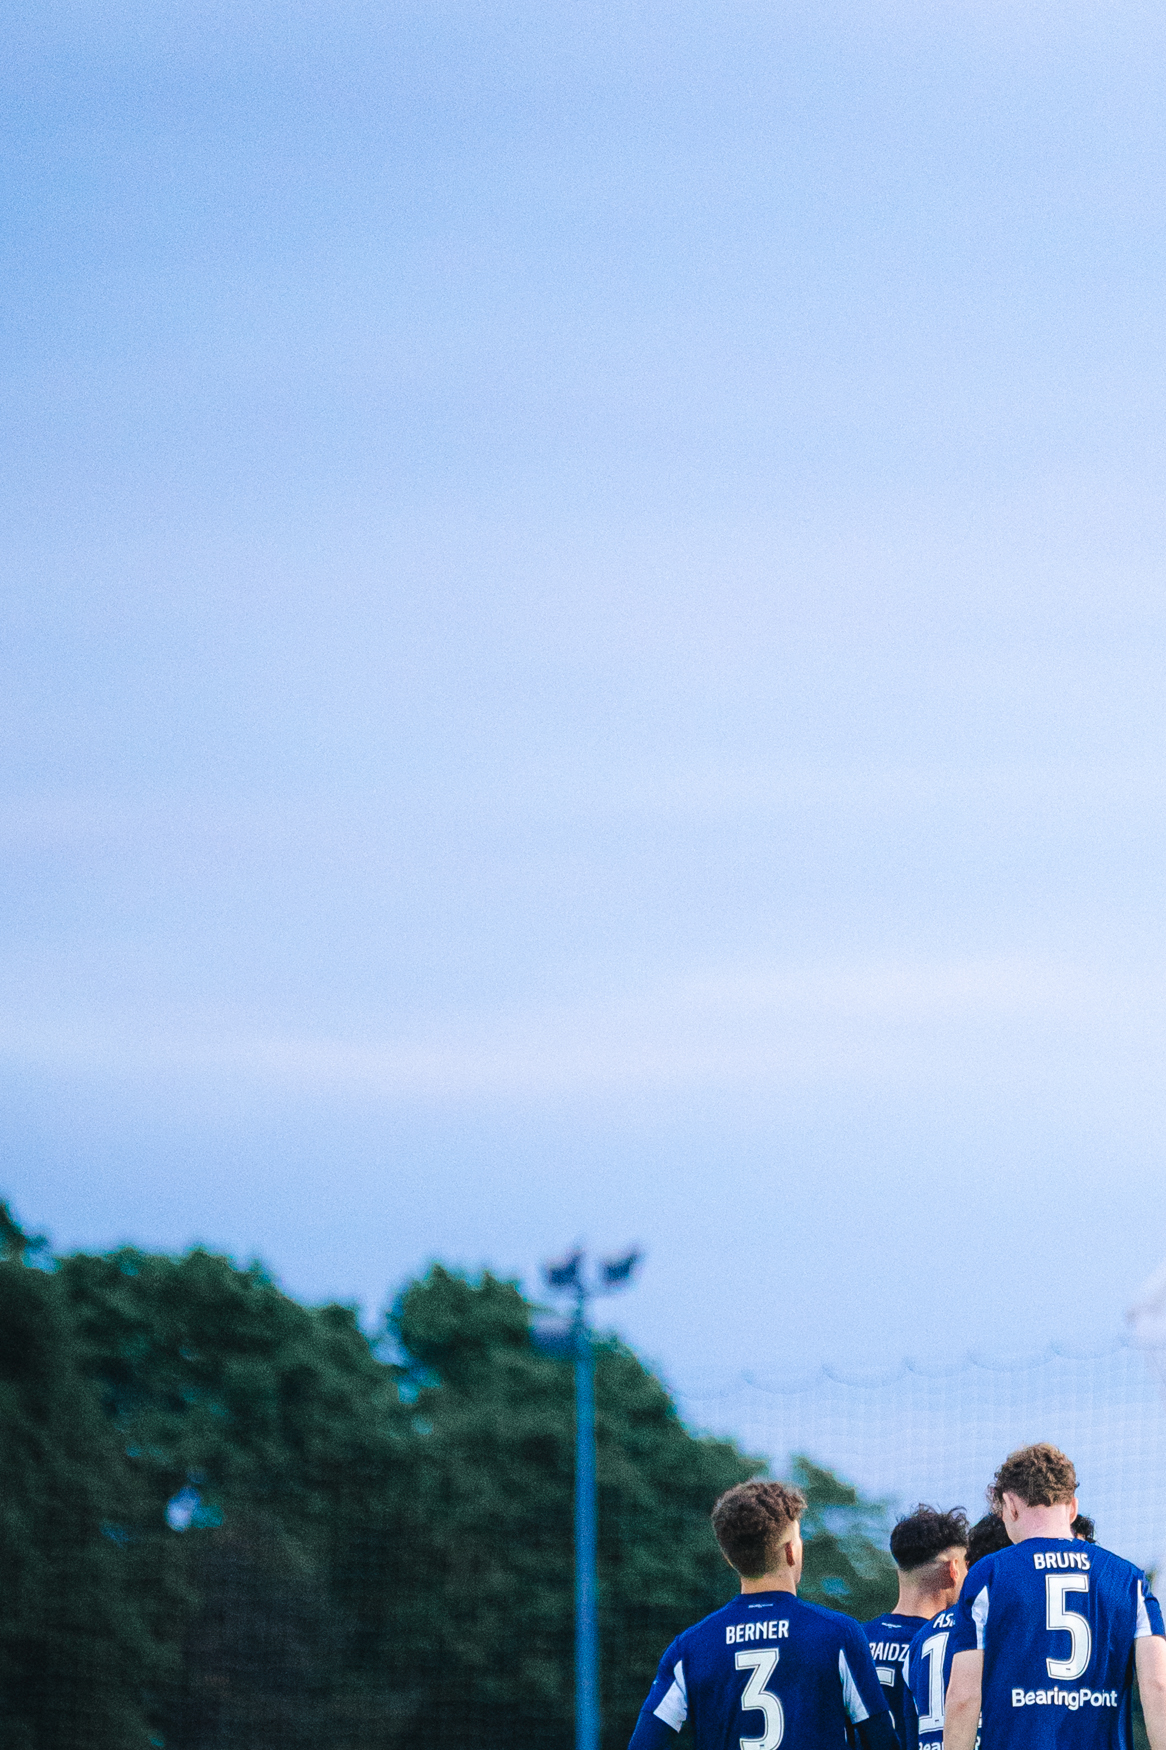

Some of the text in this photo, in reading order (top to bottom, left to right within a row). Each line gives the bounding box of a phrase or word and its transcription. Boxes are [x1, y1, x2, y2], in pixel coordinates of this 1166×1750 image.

[1033, 1552, 1090, 1570] BRUNS
[725, 1619, 789, 1645] BERNER
[1045, 1573, 1092, 1681] 5
